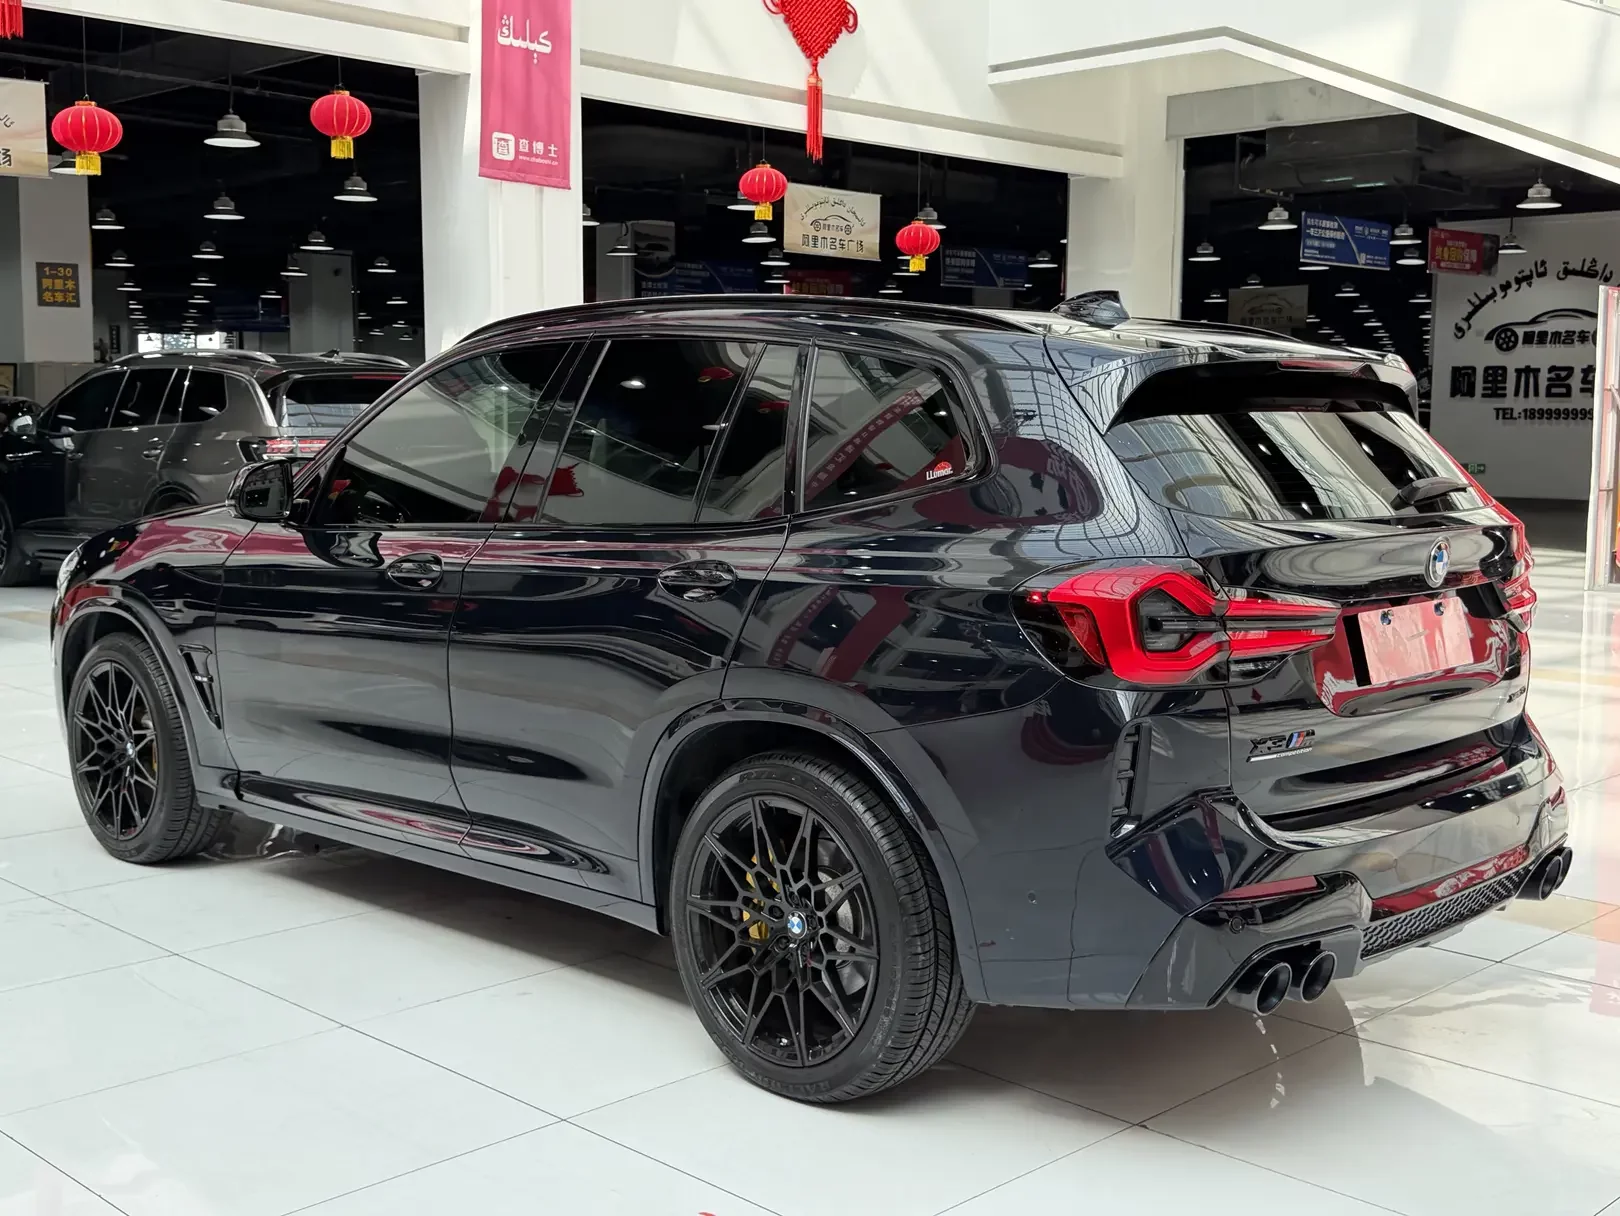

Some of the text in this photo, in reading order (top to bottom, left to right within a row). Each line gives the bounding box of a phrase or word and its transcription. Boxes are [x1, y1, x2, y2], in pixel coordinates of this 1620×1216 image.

[801, 233, 864, 253] 阿里木名车广场
[43, 266, 73, 277] 1-30
[1521, 330, 1591, 346] 阿里木名车
